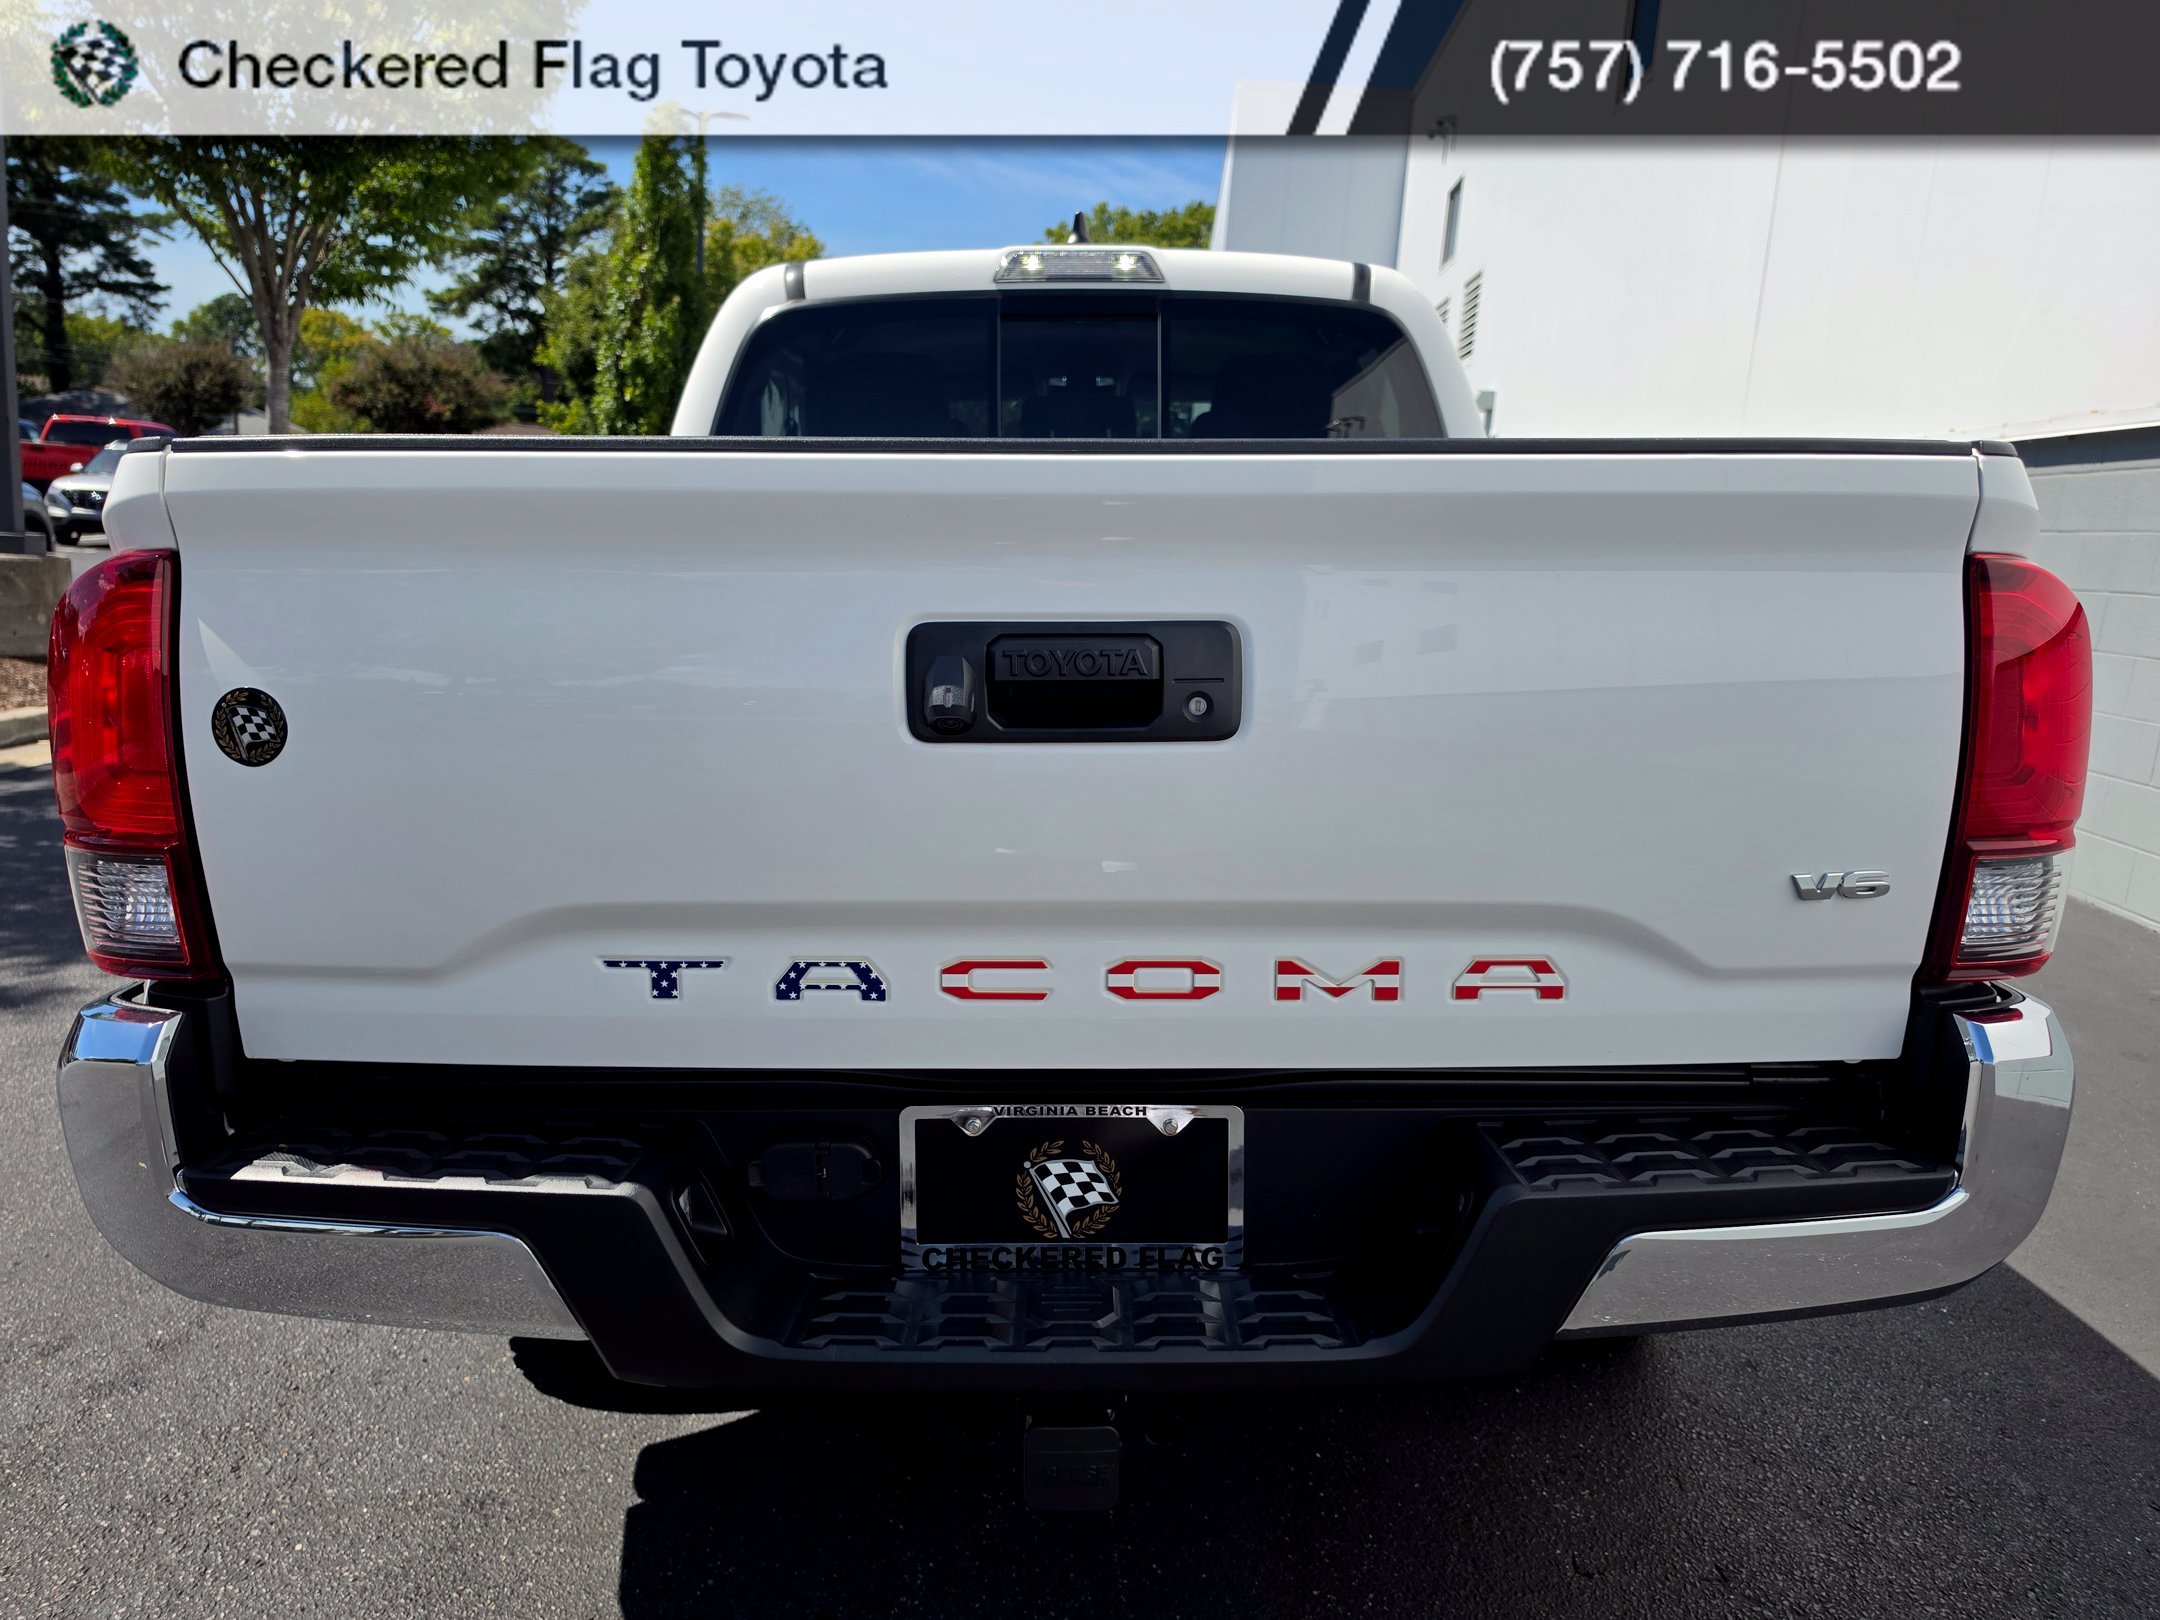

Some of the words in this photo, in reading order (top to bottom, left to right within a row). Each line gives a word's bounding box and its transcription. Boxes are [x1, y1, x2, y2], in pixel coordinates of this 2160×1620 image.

[1003, 648, 1150, 677] TOYOTA
[1790, 870, 1890, 901] V6
[598, 956, 1568, 1001] TACOMA
[993, 1105, 1078, 1116] VIRGINIA
[1085, 1105, 1147, 1116] BEACH
[921, 1246, 1127, 1271] CHECKERED
[1139, 1246, 1224, 1271] FLAG
